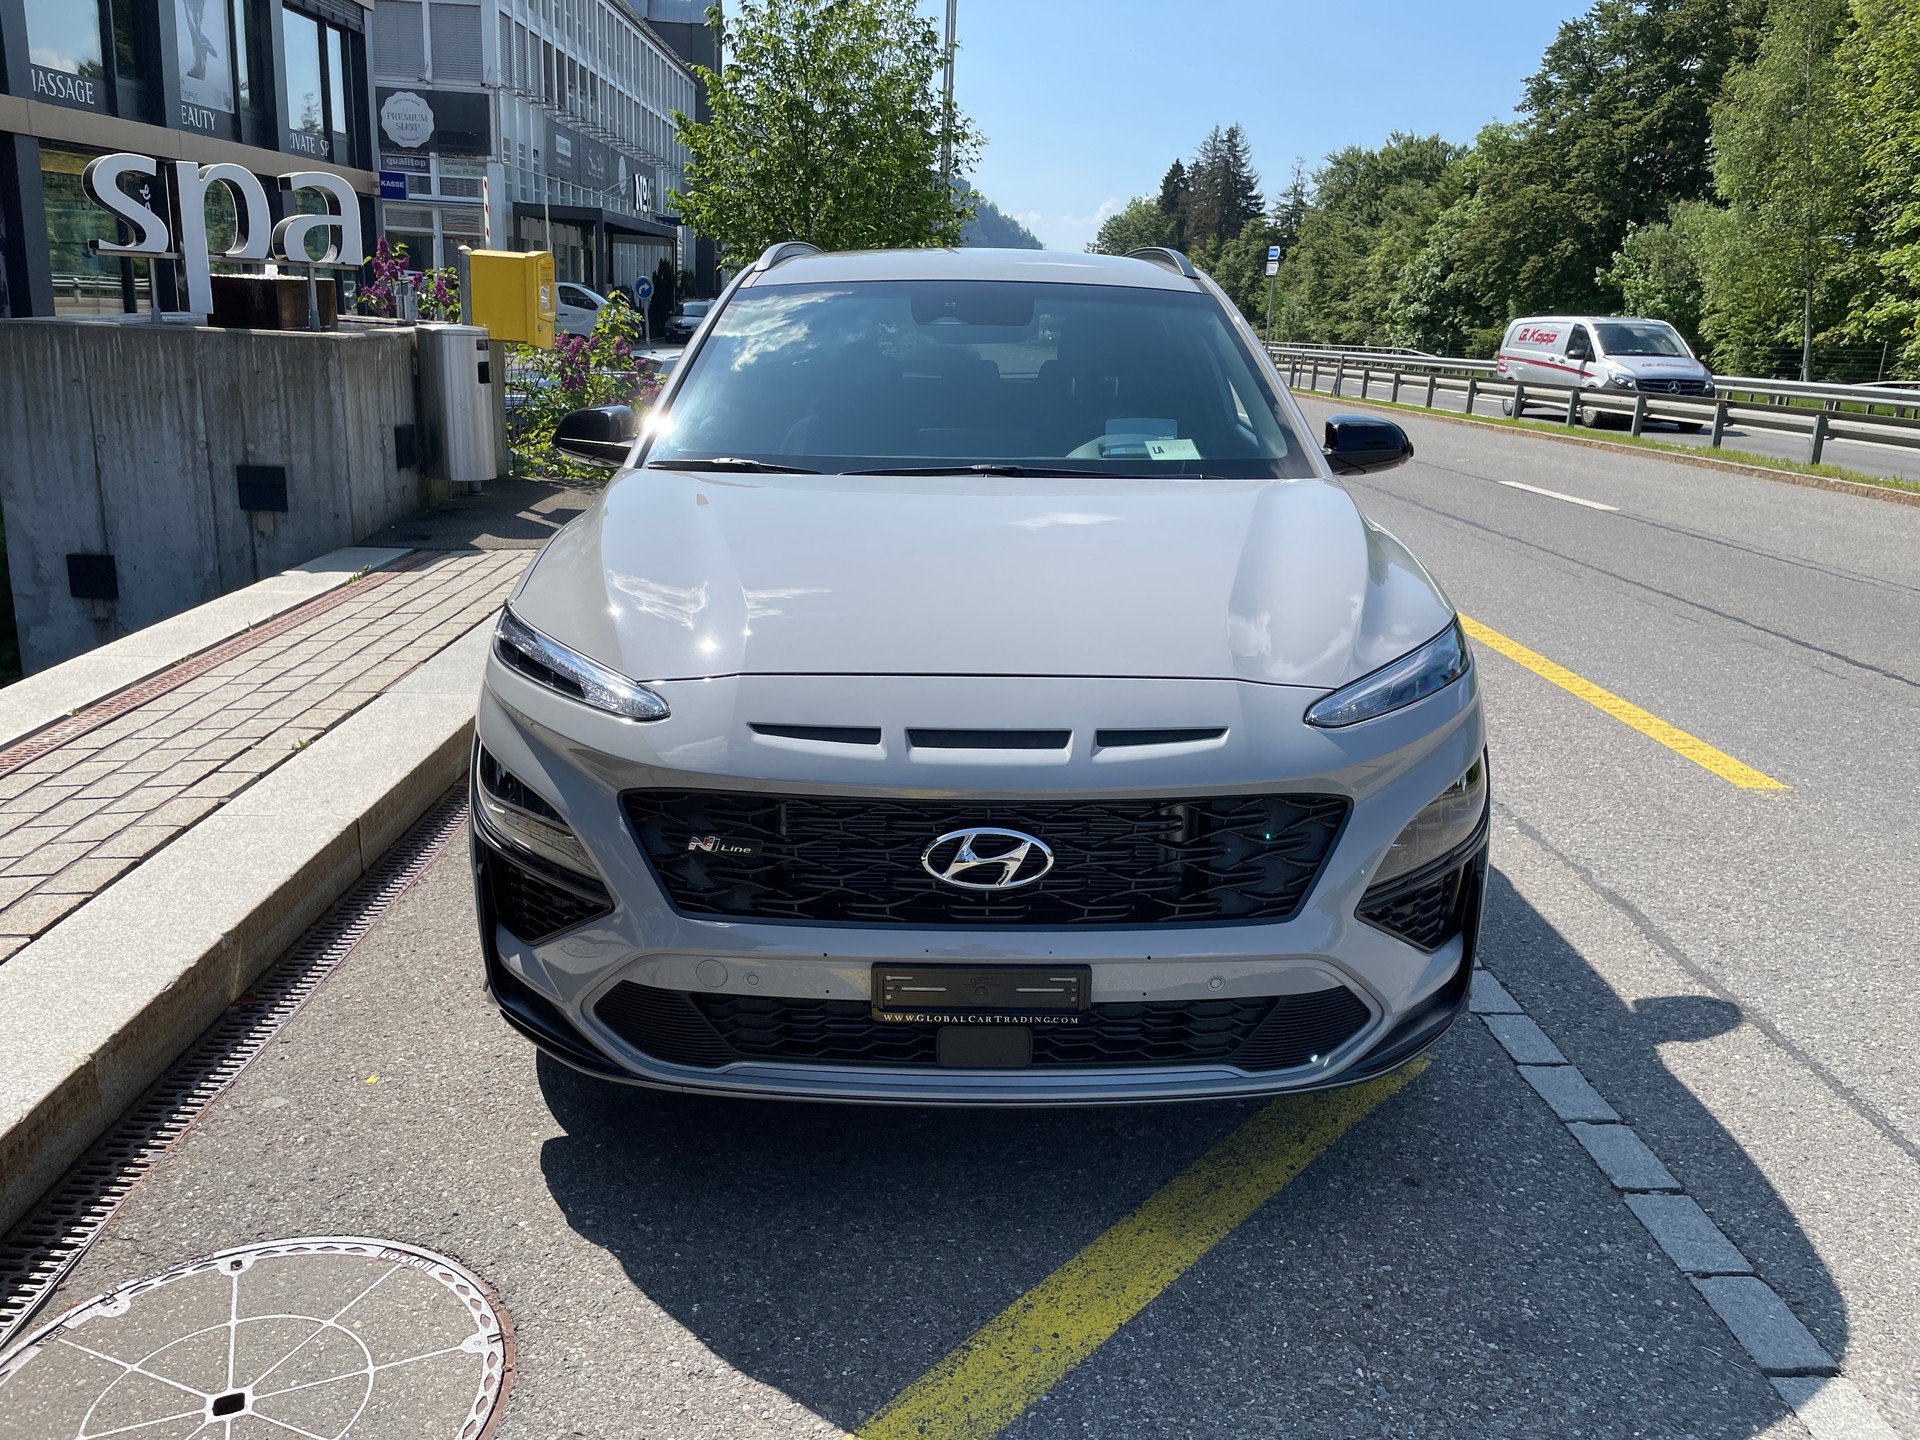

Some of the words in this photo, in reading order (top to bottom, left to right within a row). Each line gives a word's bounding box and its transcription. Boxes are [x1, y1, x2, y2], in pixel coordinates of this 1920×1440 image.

[386, 111, 428, 122] PREMIUM
[386, 157, 426, 169] qualitop
[380, 179, 405, 188] KASSE
[82, 152, 363, 314] spa
[720, 844, 752, 854] Line
